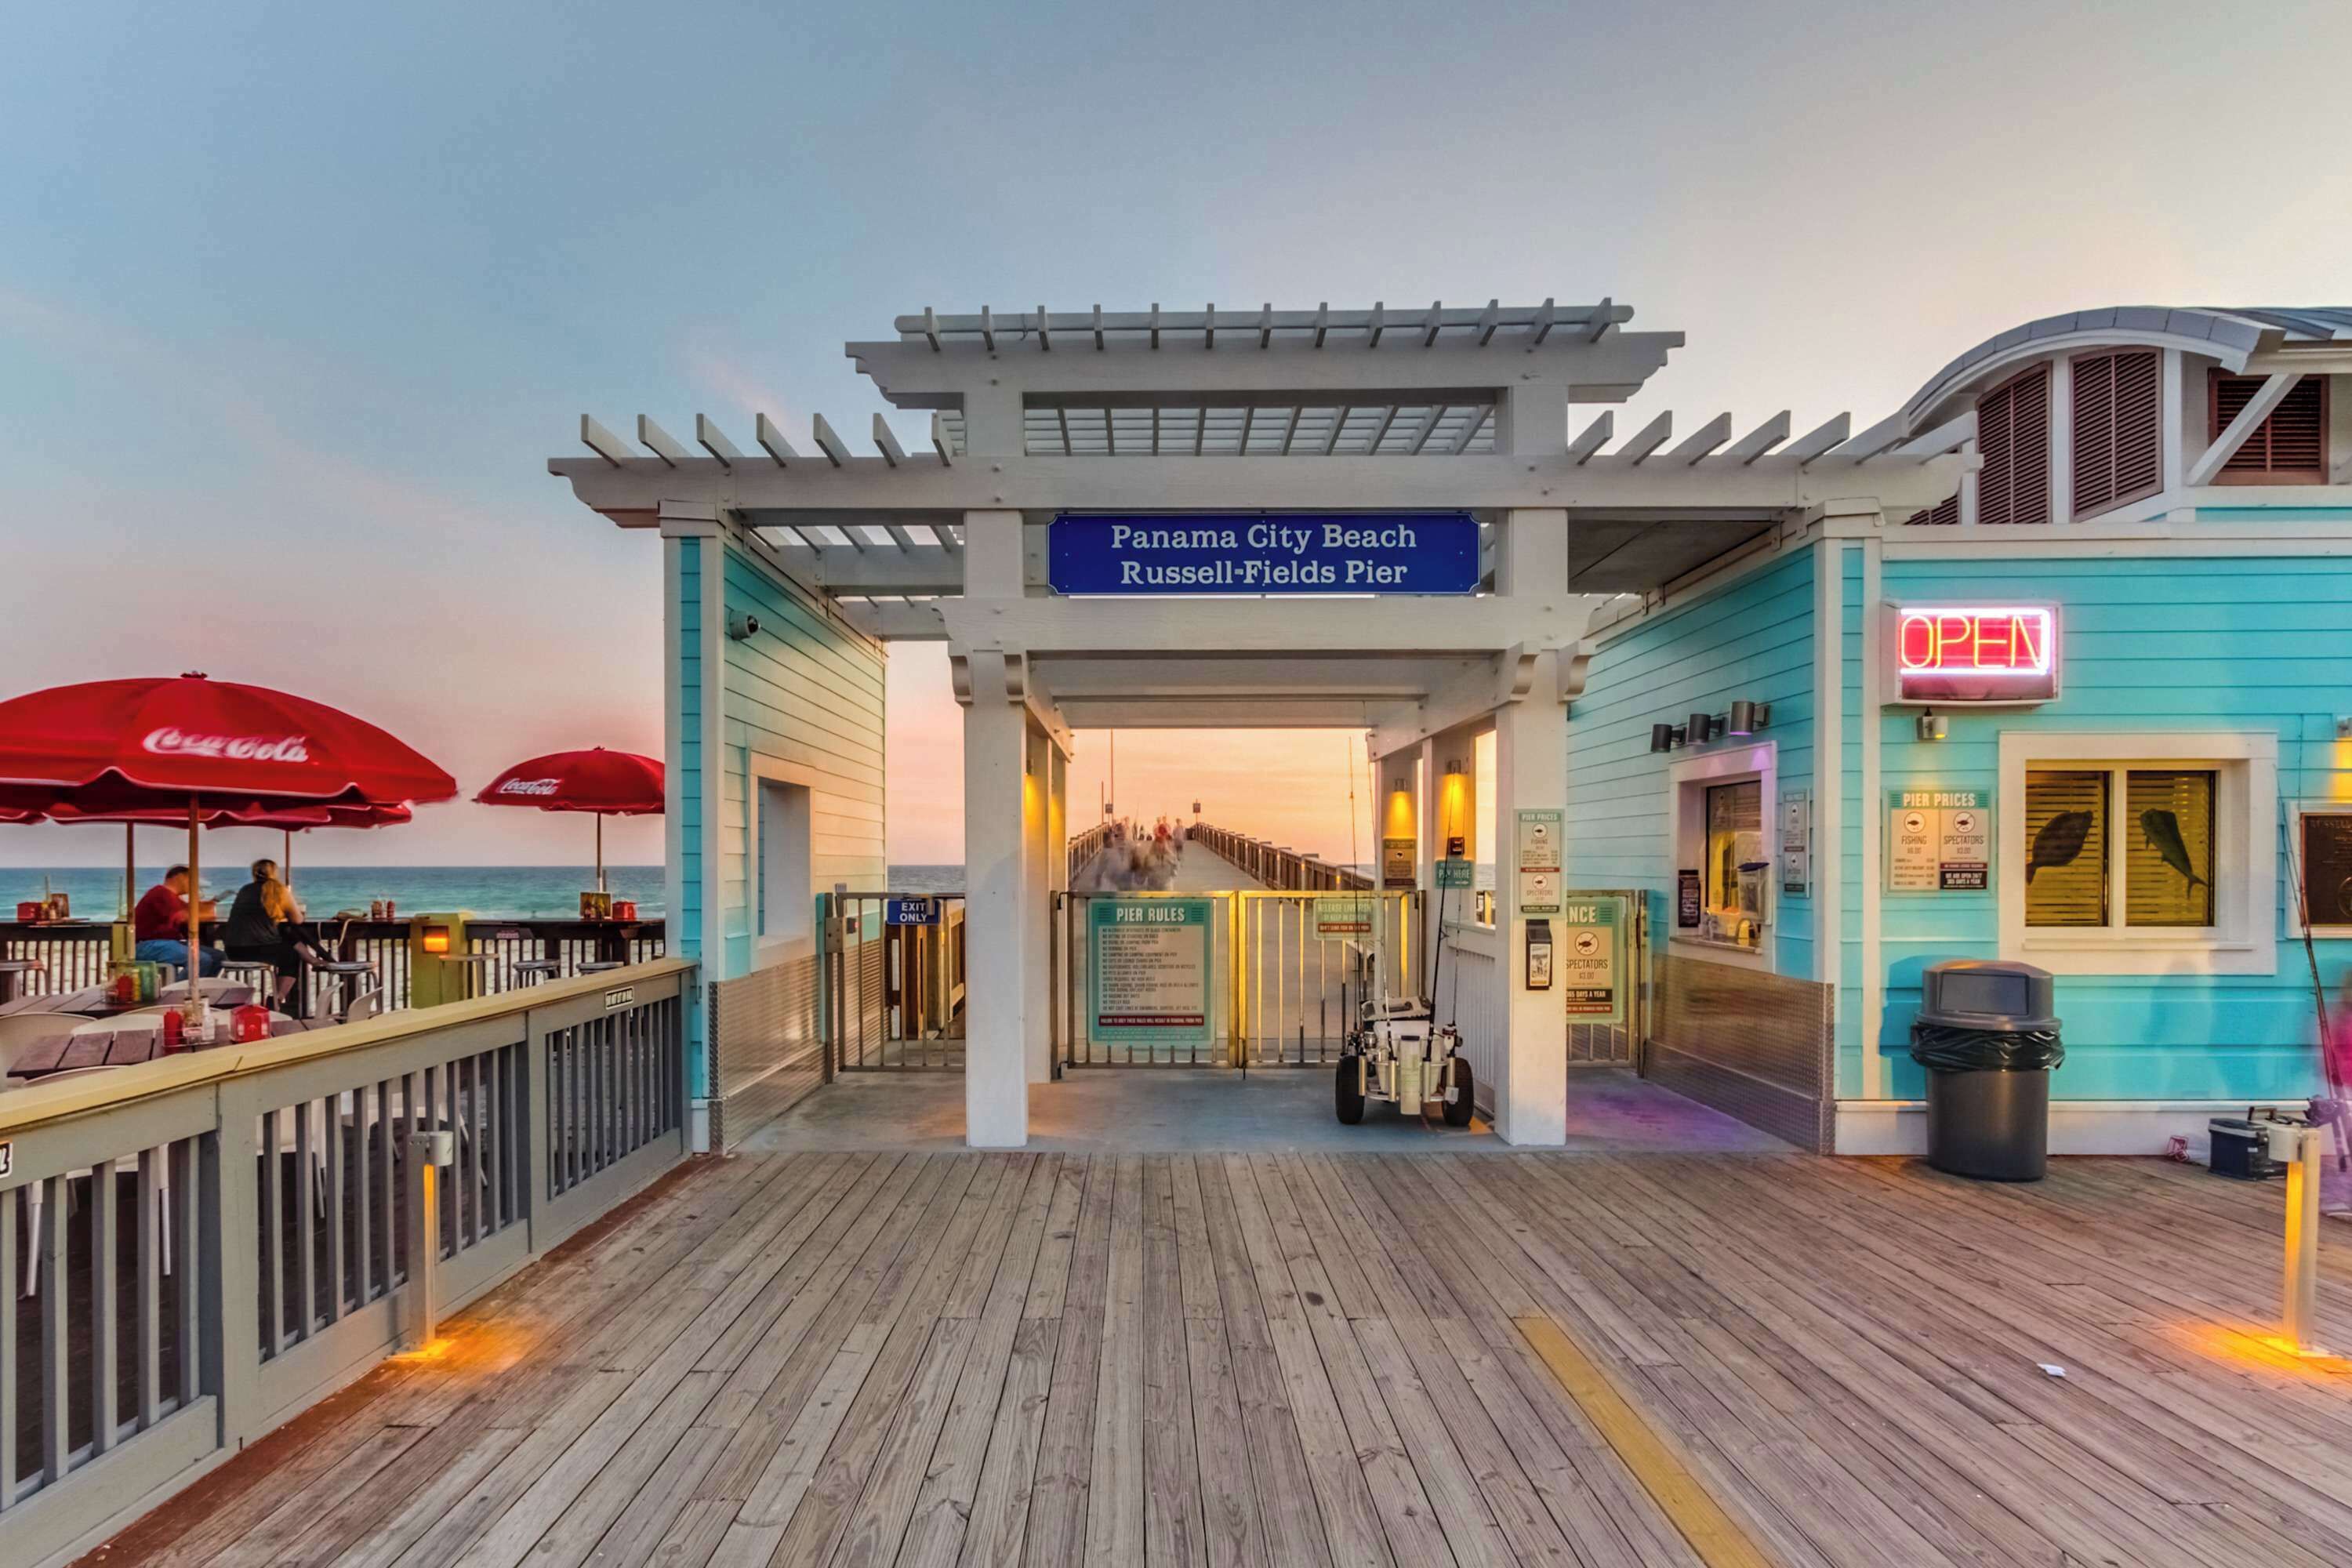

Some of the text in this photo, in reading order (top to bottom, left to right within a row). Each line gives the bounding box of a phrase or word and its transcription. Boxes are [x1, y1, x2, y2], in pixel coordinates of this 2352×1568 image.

[1112, 523, 1417, 554] Panama City Beach
[1121, 560, 1408, 585] Russell-Fields Pier
[1901, 614, 2045, 669] OPEN
[1903, 793, 1976, 807] PIER PRICES
[1901, 836, 1927, 844] FISHING
[1944, 836, 1984, 844] SPECTATORS
[1454, 869, 1469, 879] HERE
[902, 902, 925, 911] EXIT
[899, 913, 927, 922] ONLY
[1116, 908, 1185, 921] PIER RULES
